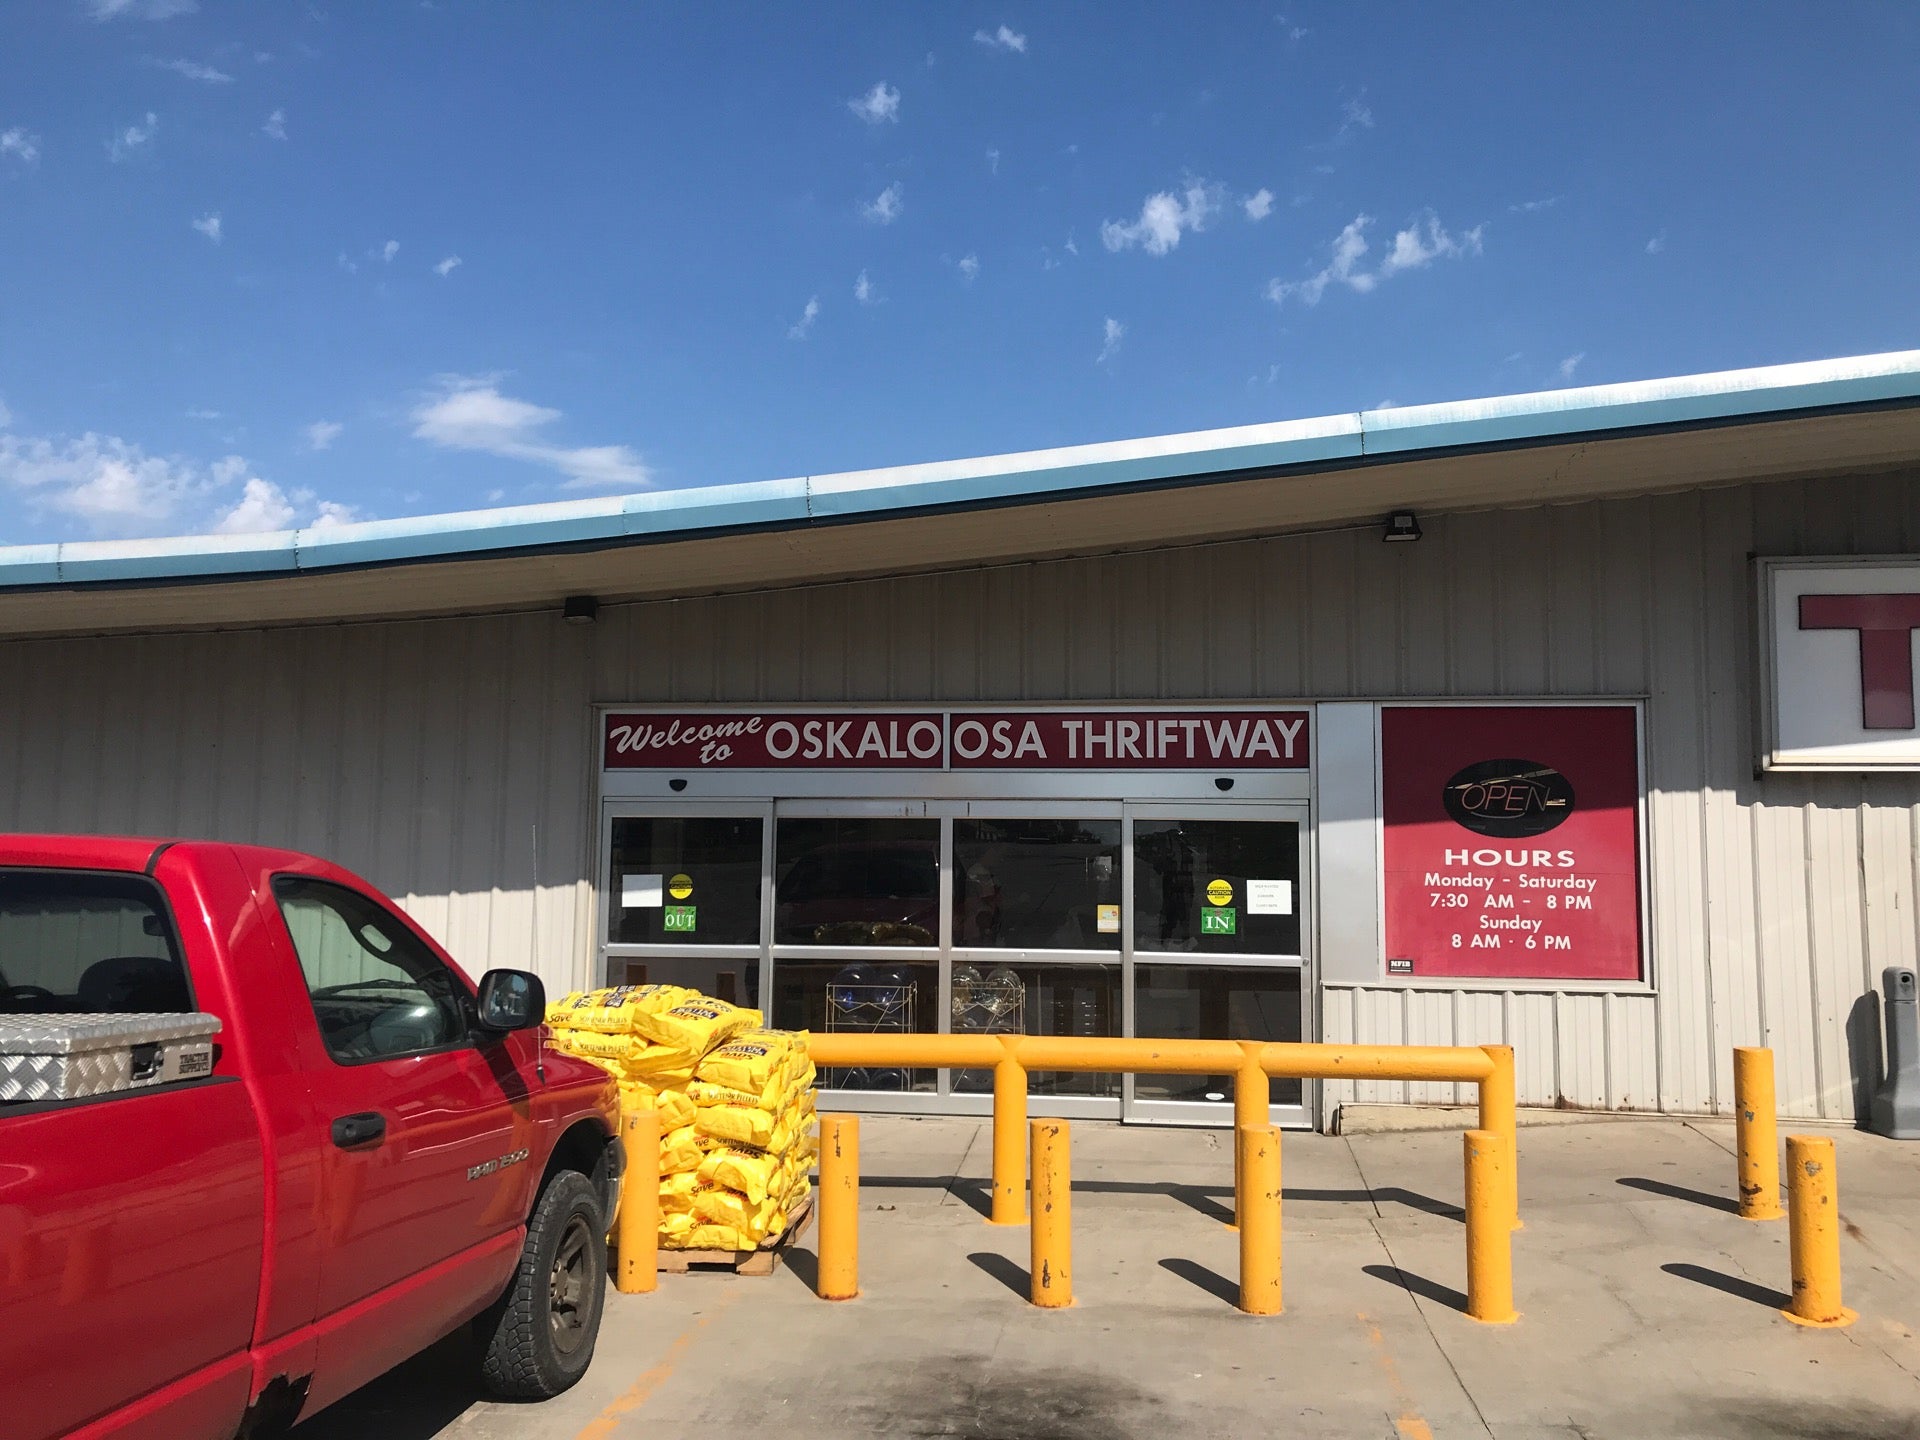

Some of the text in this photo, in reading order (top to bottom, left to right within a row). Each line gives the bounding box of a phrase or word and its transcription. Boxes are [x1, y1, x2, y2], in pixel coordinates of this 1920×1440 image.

[609, 716, 763, 753] Welcome
[1062, 719, 1305, 759] THRIFTWAY
[699, 740, 733, 764] to
[1462, 785, 1550, 811] OPEN
[1445, 849, 1575, 867] HOURS
[1424, 872, 1494, 890] Monday
[1519, 874, 1597, 892] Saturday
[1430, 893, 1469, 908] 7:30
[1484, 894, 1514, 908] AM
[1546, 895, 1557, 909] 8
[1565, 896, 1592, 910] PM
[665, 914, 694, 927] OUT
[1206, 916, 1230, 929] IN
[1480, 915, 1542, 933] Sunday
[1451, 934, 1462, 948] 8
[1470, 934, 1500, 948] AM
[1525, 936, 1536, 949] 6
[1544, 936, 1571, 950] PM
[467, 1147, 529, 1181] RAM 1500
[691, 1182, 714, 1194] Save
